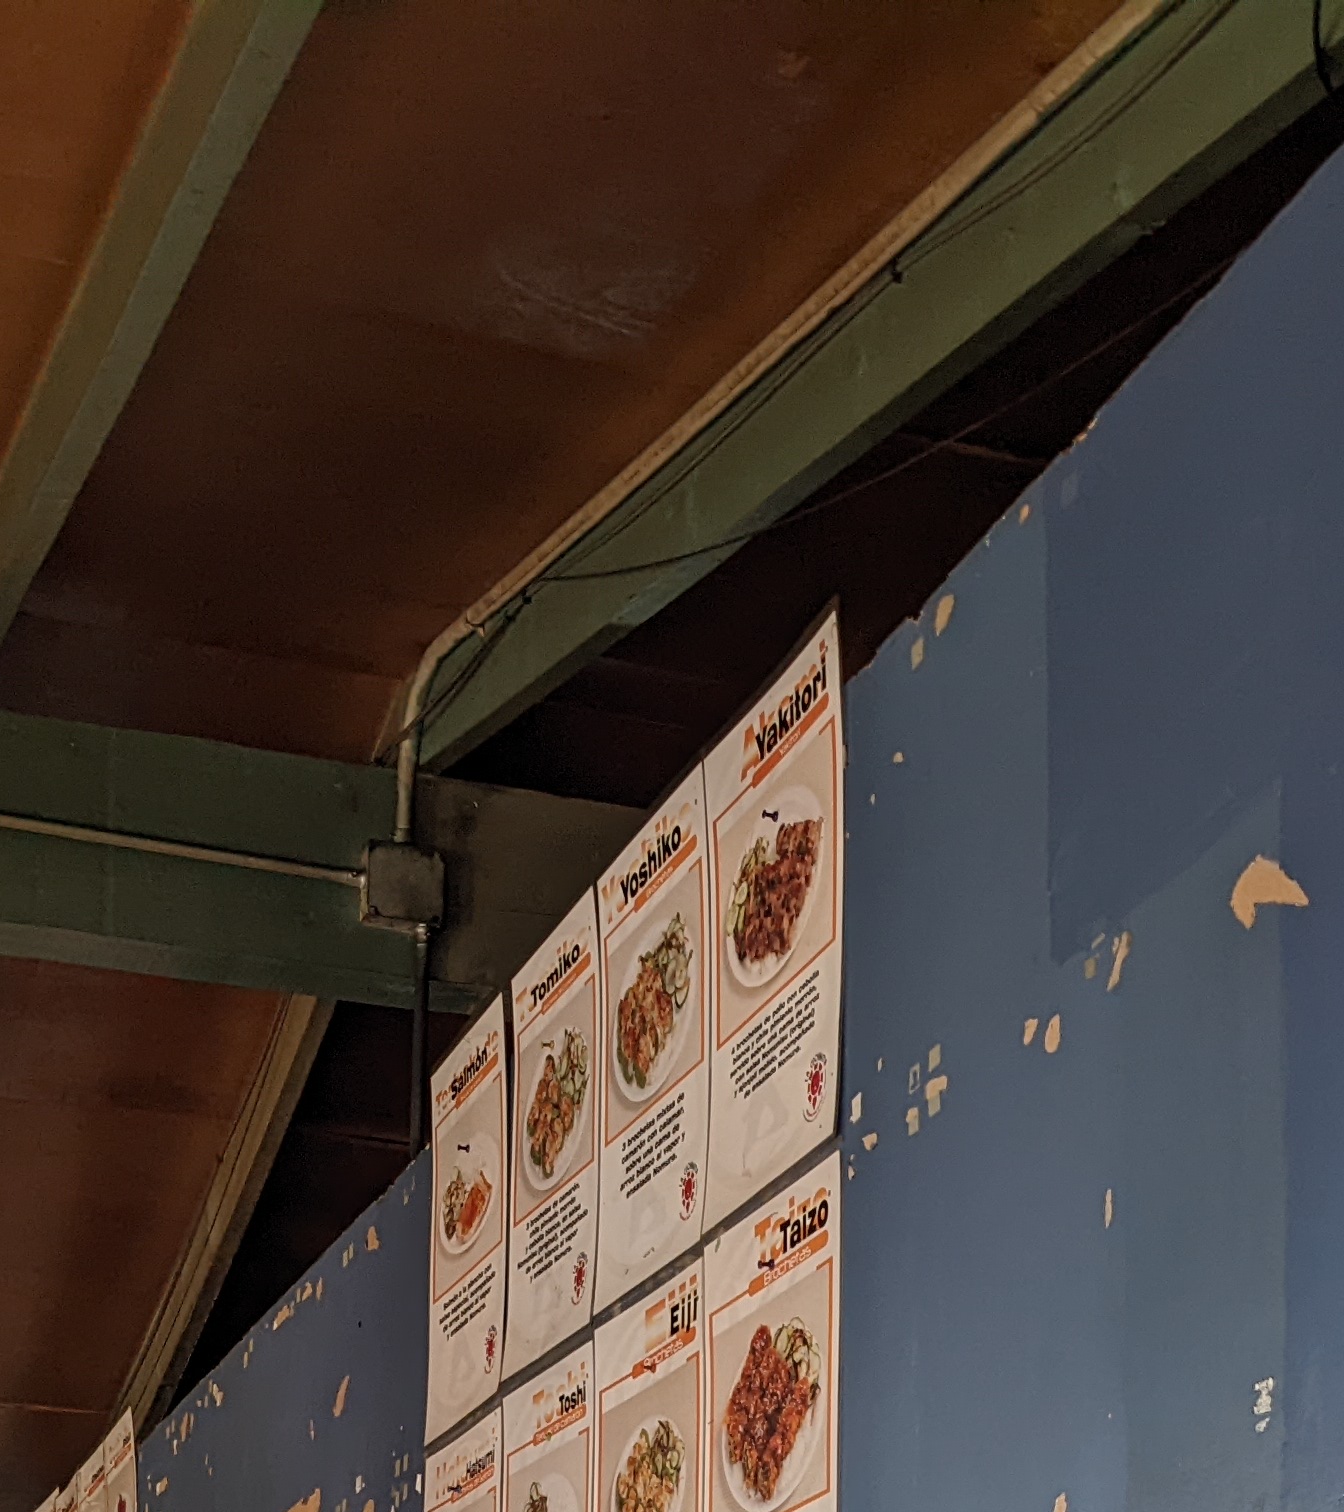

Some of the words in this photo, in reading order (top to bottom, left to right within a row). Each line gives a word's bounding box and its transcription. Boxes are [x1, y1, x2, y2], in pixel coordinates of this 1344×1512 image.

[756, 654, 827, 761] Yakitori
[620, 825, 681, 905] Yoshiko
[531, 944, 580, 1007] Tomiko
[451, 1046, 488, 1101] Salmón
[780, 1199, 829, 1254] Taizo
[763, 1246, 812, 1286] Brochetas
[670, 1289, 699, 1337] Eiji
[558, 1380, 586, 1416] Toshi
